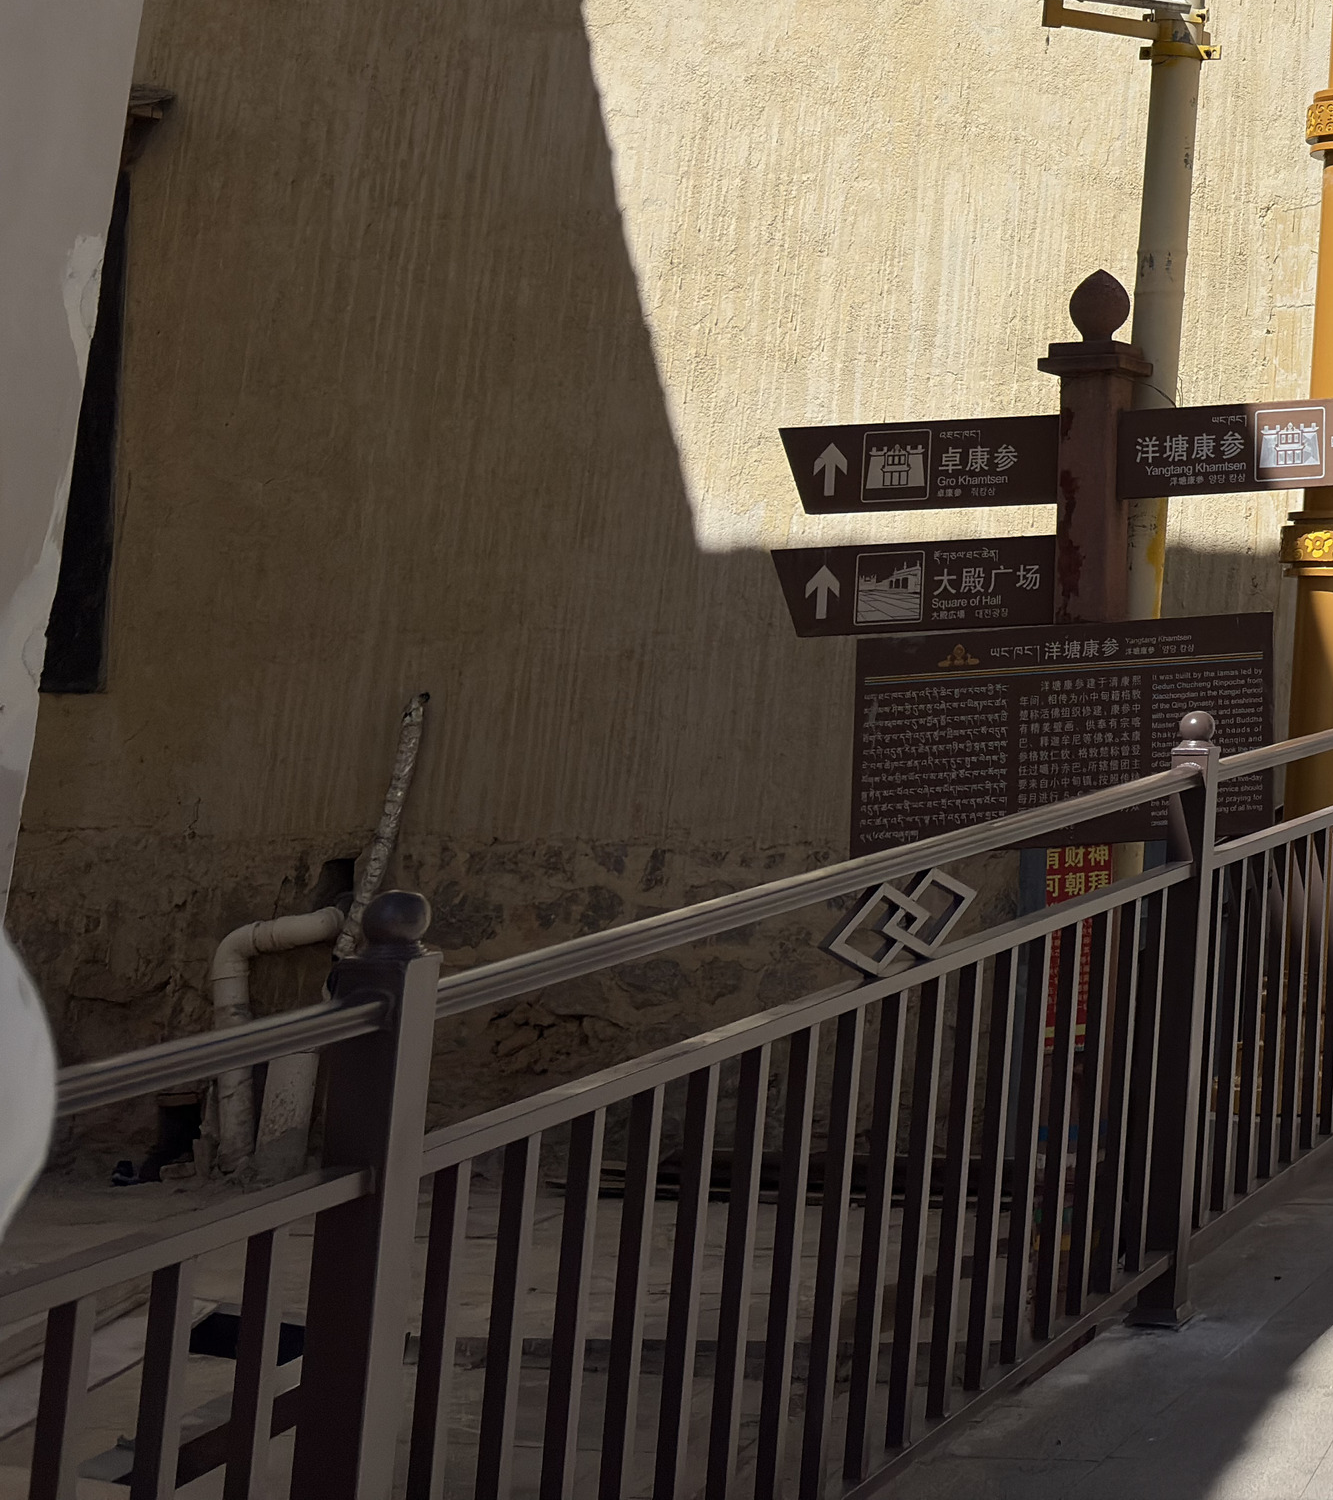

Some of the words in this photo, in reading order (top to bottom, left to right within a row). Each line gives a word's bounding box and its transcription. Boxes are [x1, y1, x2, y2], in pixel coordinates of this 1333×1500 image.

[1135, 430, 1245, 464] 洋塘康参
[937, 443, 1018, 474] 卓康参
[1145, 464, 1193, 477] Yangtang
[1196, 461, 1247, 473] Khamtsen
[937, 476, 956, 487] Gro
[958, 475, 1009, 486] Khamtsen
[933, 564, 1041, 596] 大殿广场
[932, 598, 968, 610] Square
[969, 596, 981, 607] of
[982, 595, 1002, 606] Hall
[1125, 637, 1157, 645] Yangtang
[1158, 634, 1192, 643] Khamtsen
[1044, 637, 1119, 660] 洋塘康参
[1193, 672, 1201, 680] by
[1254, 668, 1262, 676] by
